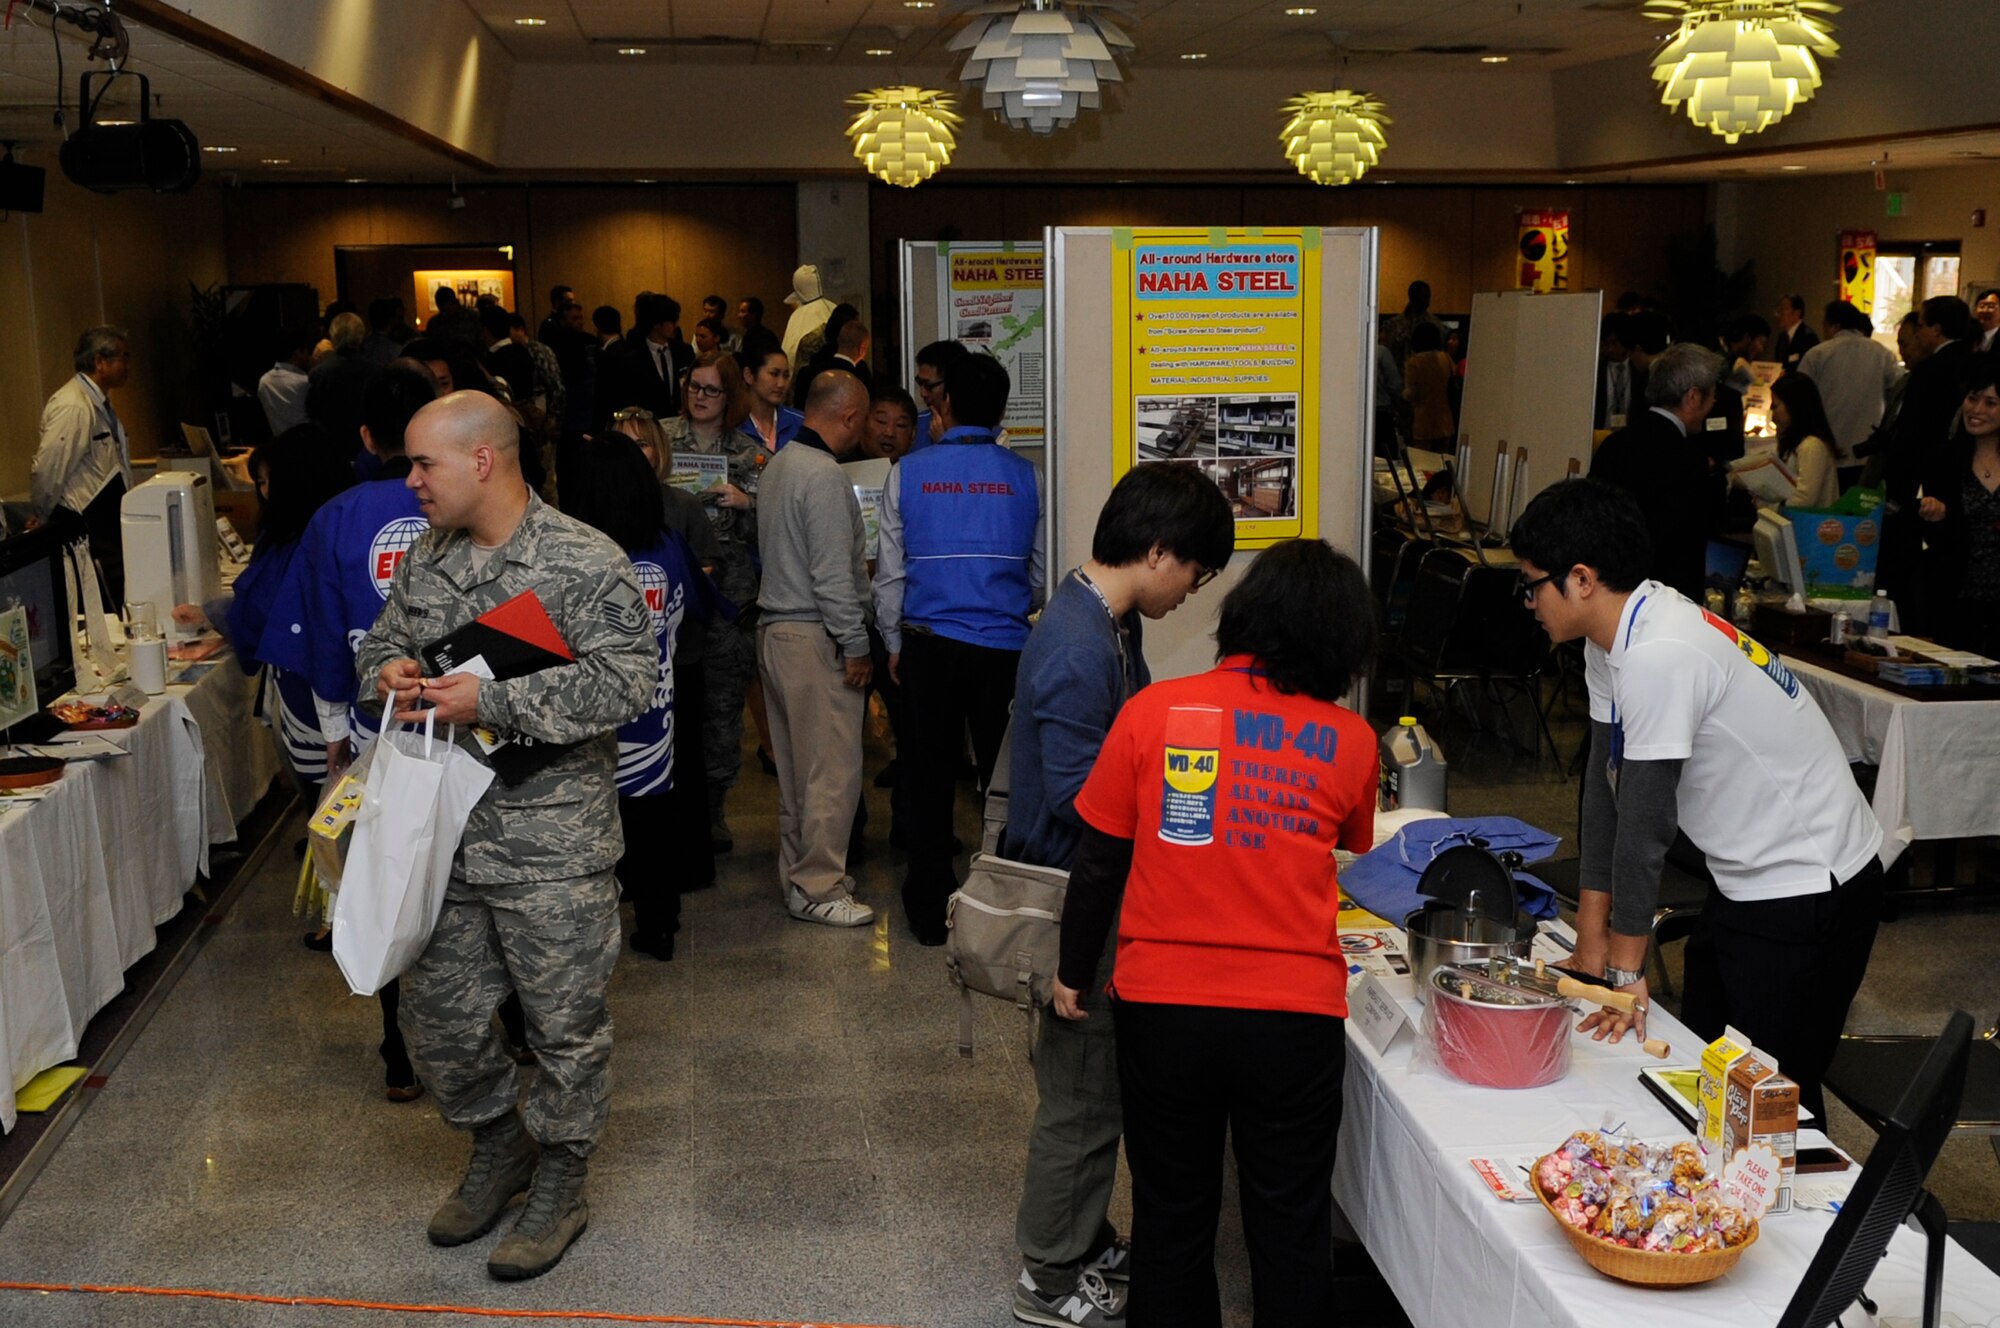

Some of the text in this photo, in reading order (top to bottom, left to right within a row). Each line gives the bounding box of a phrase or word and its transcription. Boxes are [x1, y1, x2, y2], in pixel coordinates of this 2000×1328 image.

[1140, 252, 1295, 265] All-around Hardware store
[954, 268, 1044, 281] NAHA STEE
[1139, 271, 1294, 292] NAHA STEEL
[700, 462, 725, 470] STEEL
[922, 482, 1016, 496] NAHA STEEL
[645, 588, 663, 611] KI
[1233, 709, 1339, 763] WD-40
[1167, 752, 1214, 773] WD-40
[1232, 760, 1318, 790] THERE'S
[1228, 783, 1310, 810] ALWAYS
[1226, 806, 1319, 835] ANOTHER
[1224, 830, 1267, 849] USE
[1744, 1159, 1769, 1181] PLEASE
[1736, 1170, 1767, 1197] TAKE ONE
[1058, 1295, 1094, 1325] N
